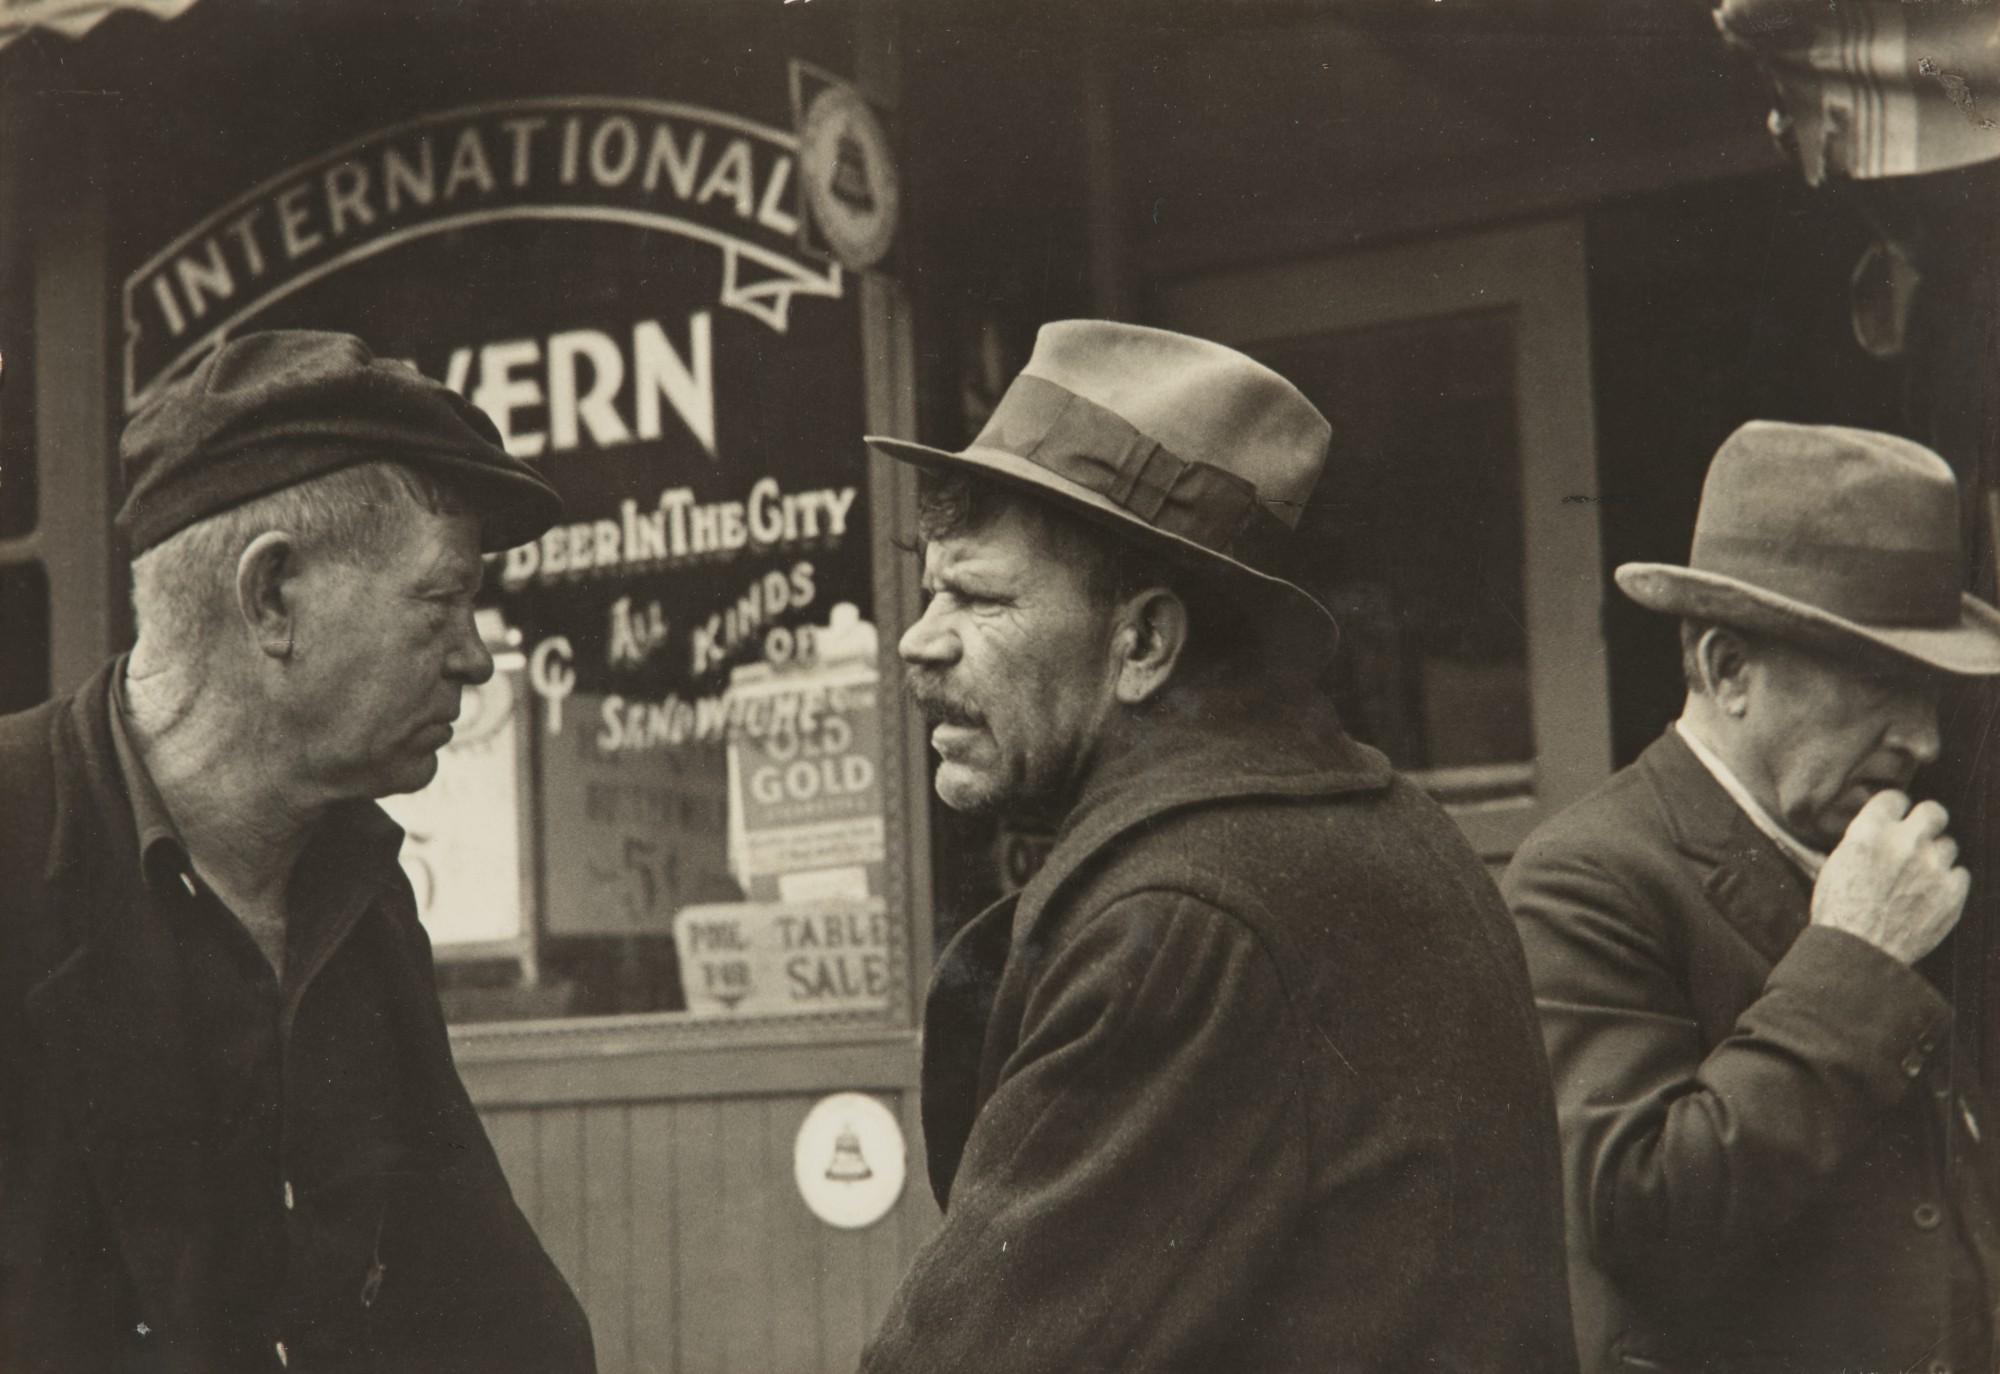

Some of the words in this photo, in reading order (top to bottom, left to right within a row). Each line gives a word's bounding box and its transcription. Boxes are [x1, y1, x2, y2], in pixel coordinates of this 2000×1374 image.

[152, 116, 799, 337] INTERNATIONAL
[749, 477, 855, 545] CITY
[693, 561, 816, 675] KINDS
[751, 754, 874, 804] GOLD
[785, 955, 888, 1000] SALE
